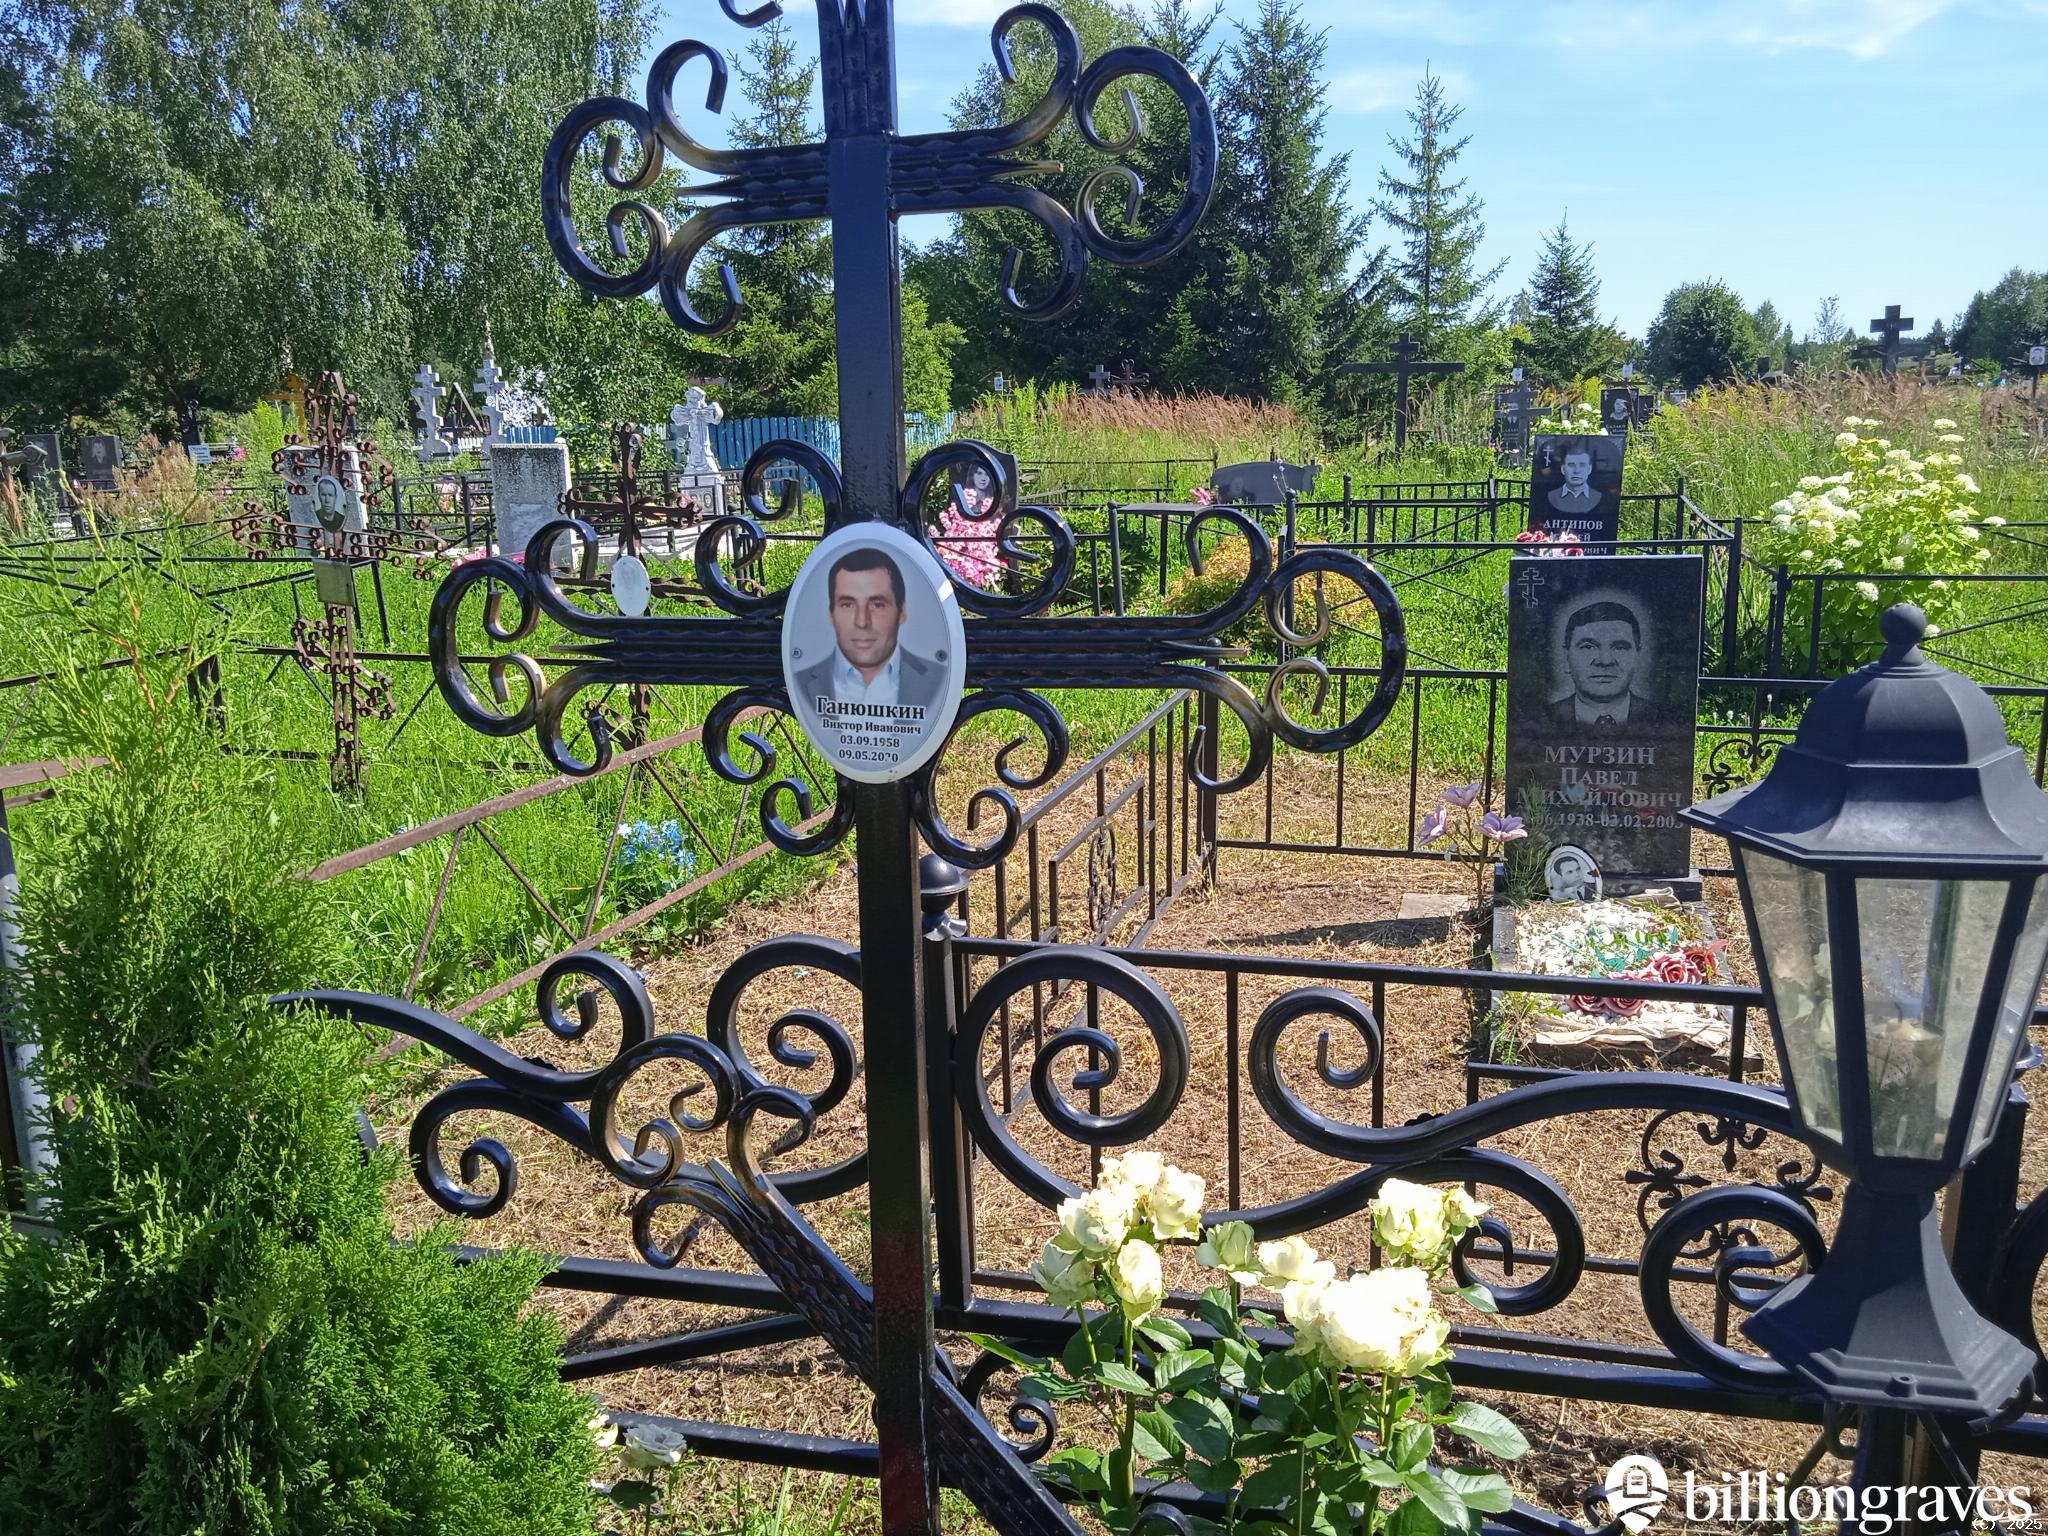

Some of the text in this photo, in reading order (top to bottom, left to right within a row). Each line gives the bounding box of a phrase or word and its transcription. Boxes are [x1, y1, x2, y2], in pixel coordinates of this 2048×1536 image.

[1543, 519, 1604, 531] АНТИПОВ
[817, 697, 925, 720] Ганюшкин
[822, 719, 921, 735] Виктор Иванович
[840, 734, 900, 748] 03.09.1958
[1544, 746, 1657, 766] МУРЗИН
[1560, 767, 1639, 786] ПАВЕЛ
[1516, 787, 1682, 808] МИХЙЛОВИЧ
